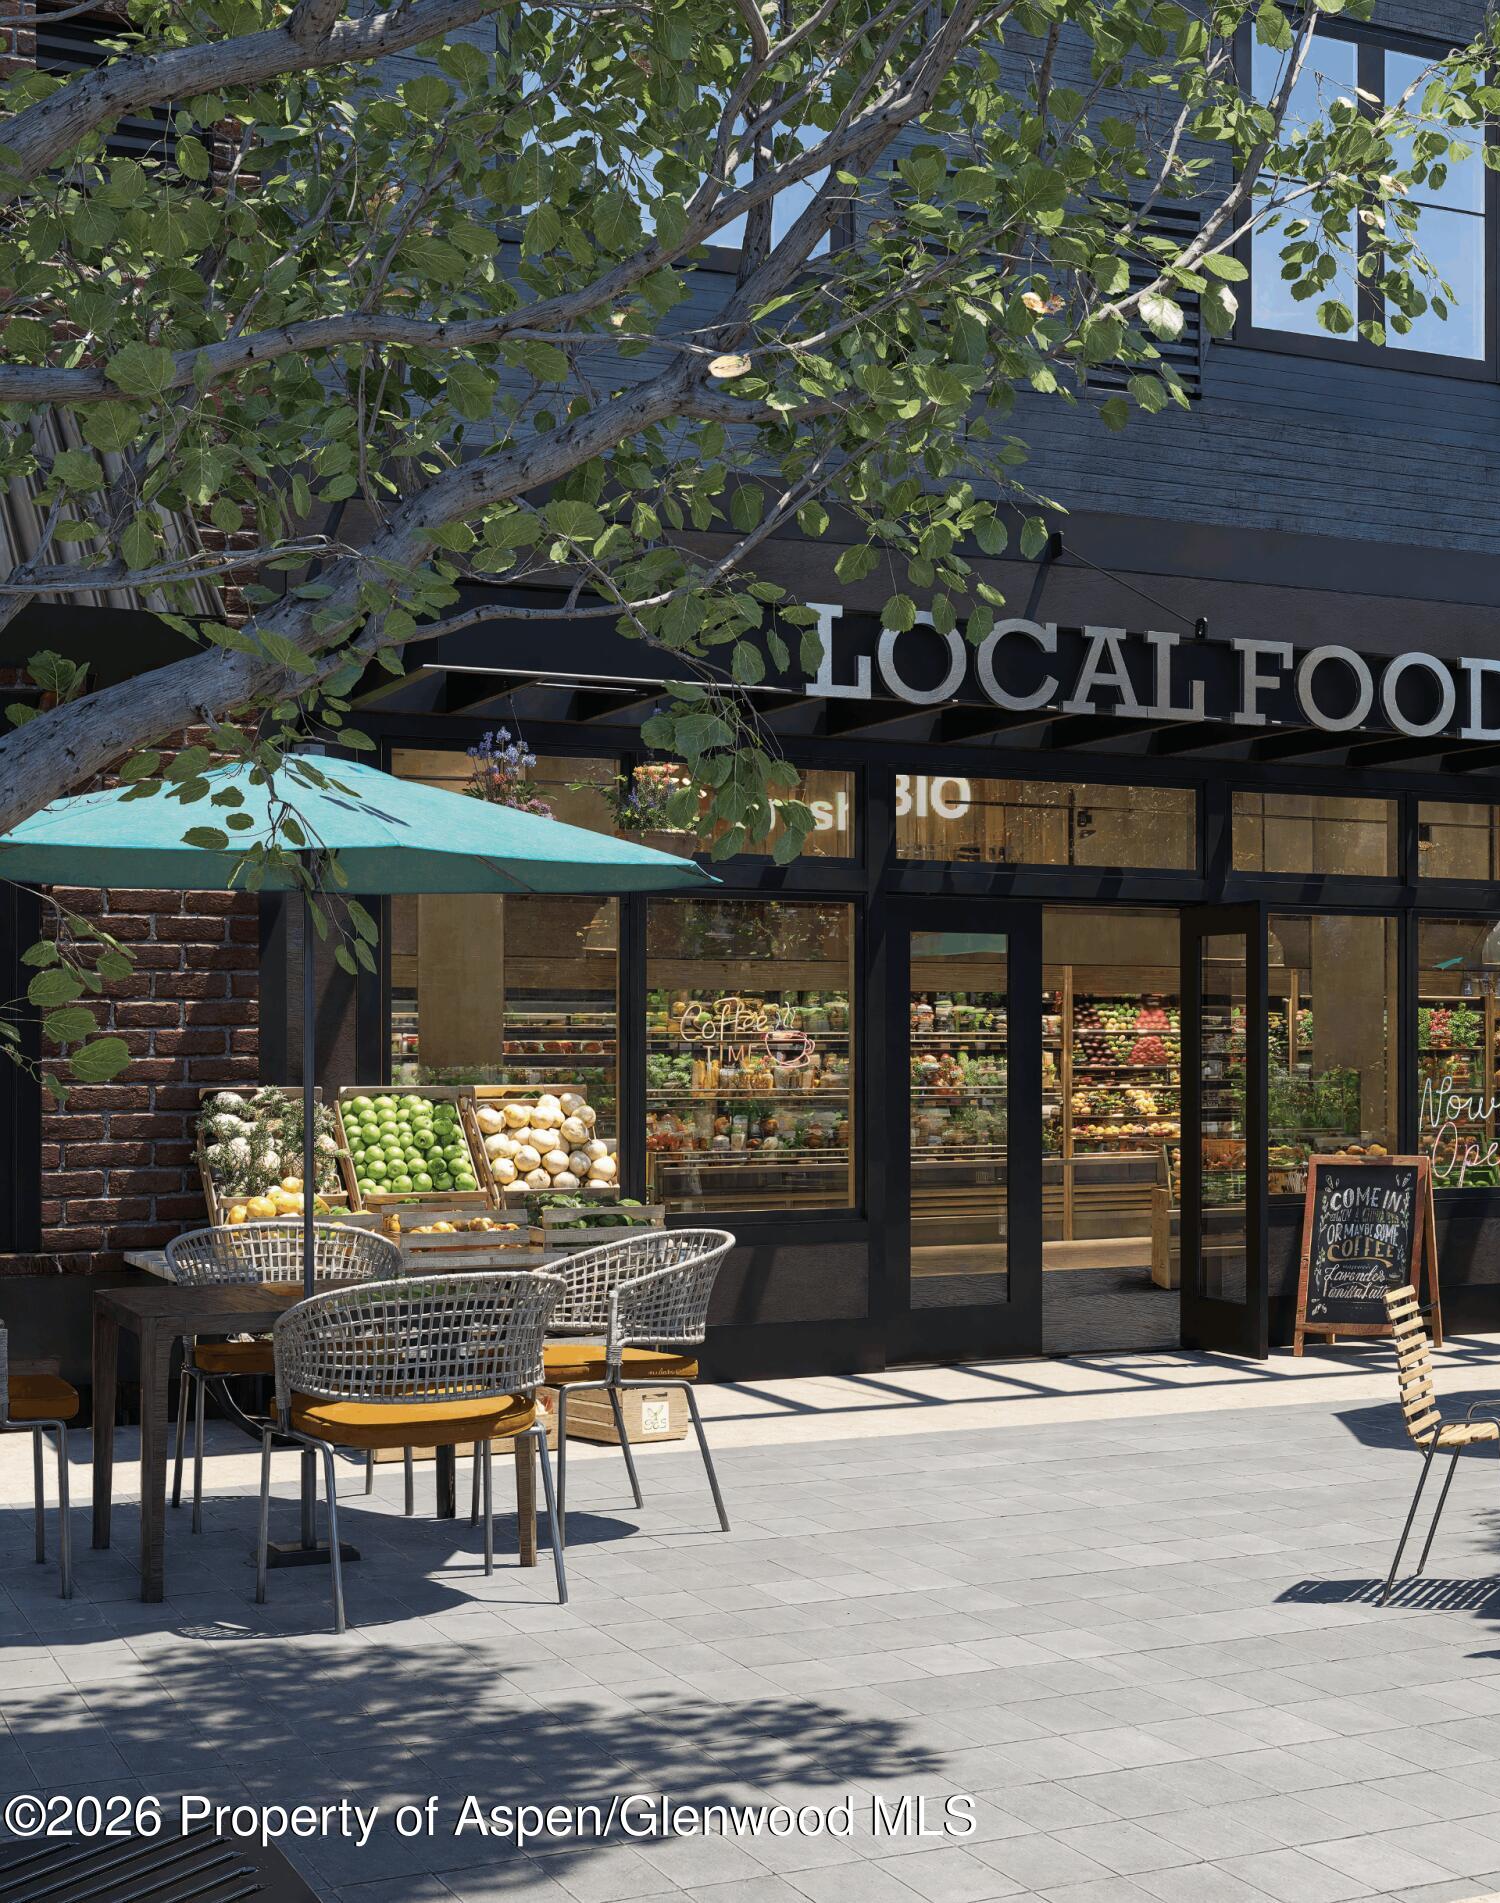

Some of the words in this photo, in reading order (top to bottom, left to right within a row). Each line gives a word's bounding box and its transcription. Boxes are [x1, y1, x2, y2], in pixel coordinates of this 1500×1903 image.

[803, 602, 1206, 721] LOCAL
[1330, 1186, 1382, 1211] COME
[1383, 1190, 1402, 1212] IN
[1326, 1223, 1343, 1245] OR
[1327, 1235, 1395, 1262] COFFEE
